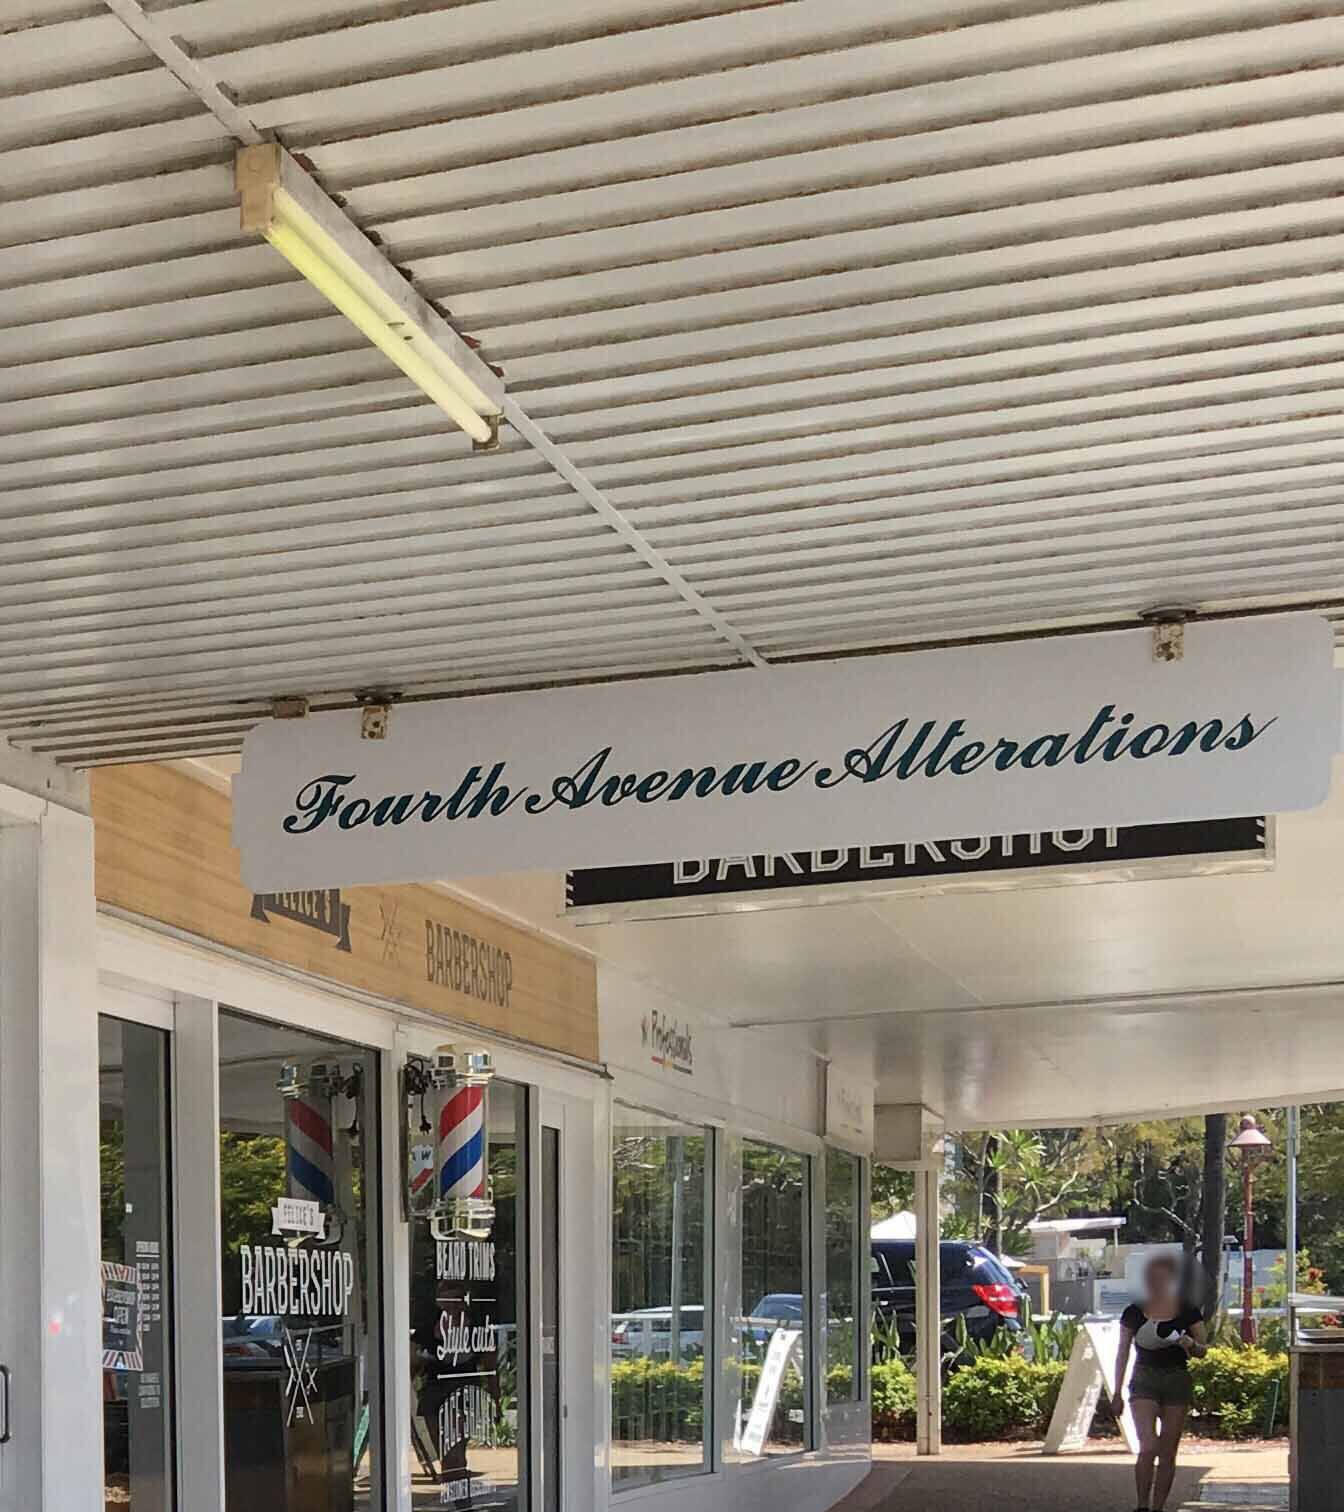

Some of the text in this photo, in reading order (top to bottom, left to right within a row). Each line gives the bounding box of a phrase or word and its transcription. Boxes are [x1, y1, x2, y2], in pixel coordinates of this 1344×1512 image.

[282, 703, 1275, 834] Fourth Avenue Alterations
[424, 919, 513, 1007] BARBERSHOP
[240, 1245, 354, 1317] BARBERSHOP
[436, 1240, 496, 1282] BEARD TRIMS
[437, 1310, 497, 1367] Style cuts
